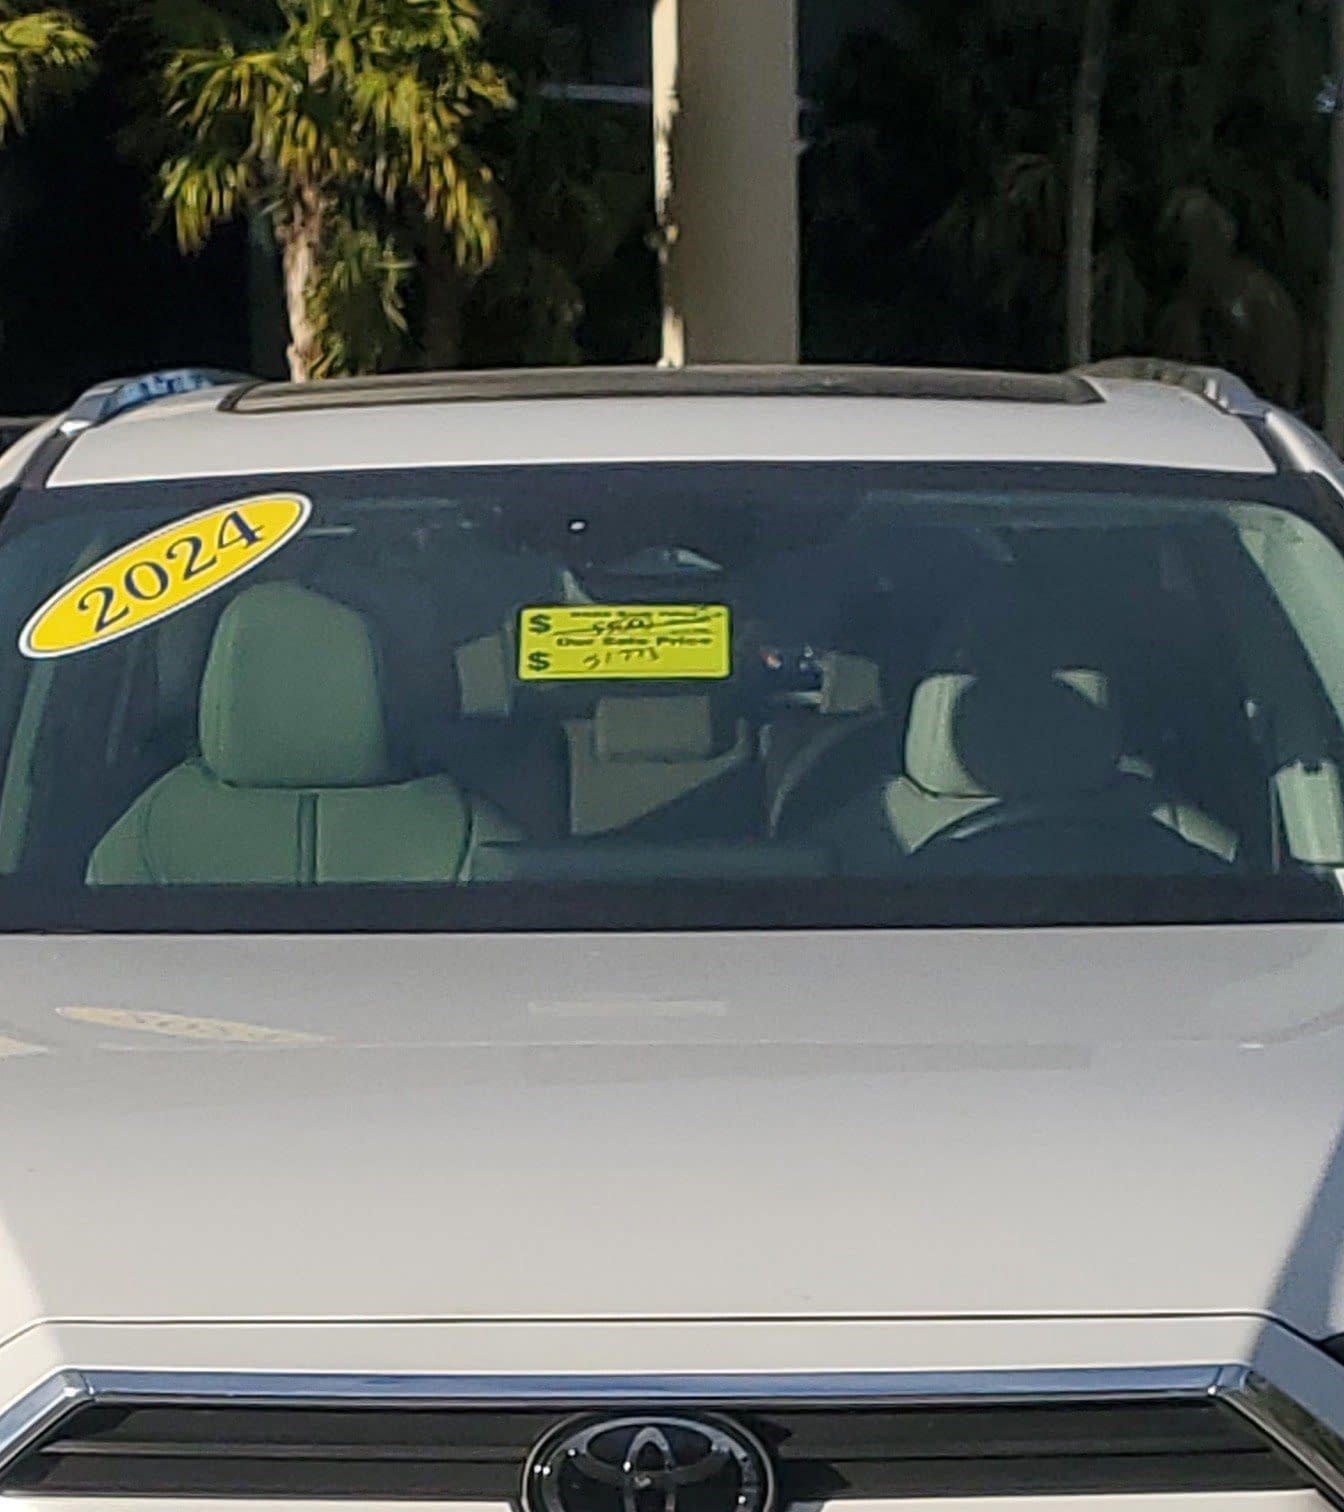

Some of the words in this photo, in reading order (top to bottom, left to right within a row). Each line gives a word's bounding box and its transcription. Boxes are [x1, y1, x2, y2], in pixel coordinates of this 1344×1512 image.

[77, 510, 265, 633] 2024
[529, 613, 552, 634] $
[656, 636, 713, 647] Price
[528, 651, 552, 672] $
